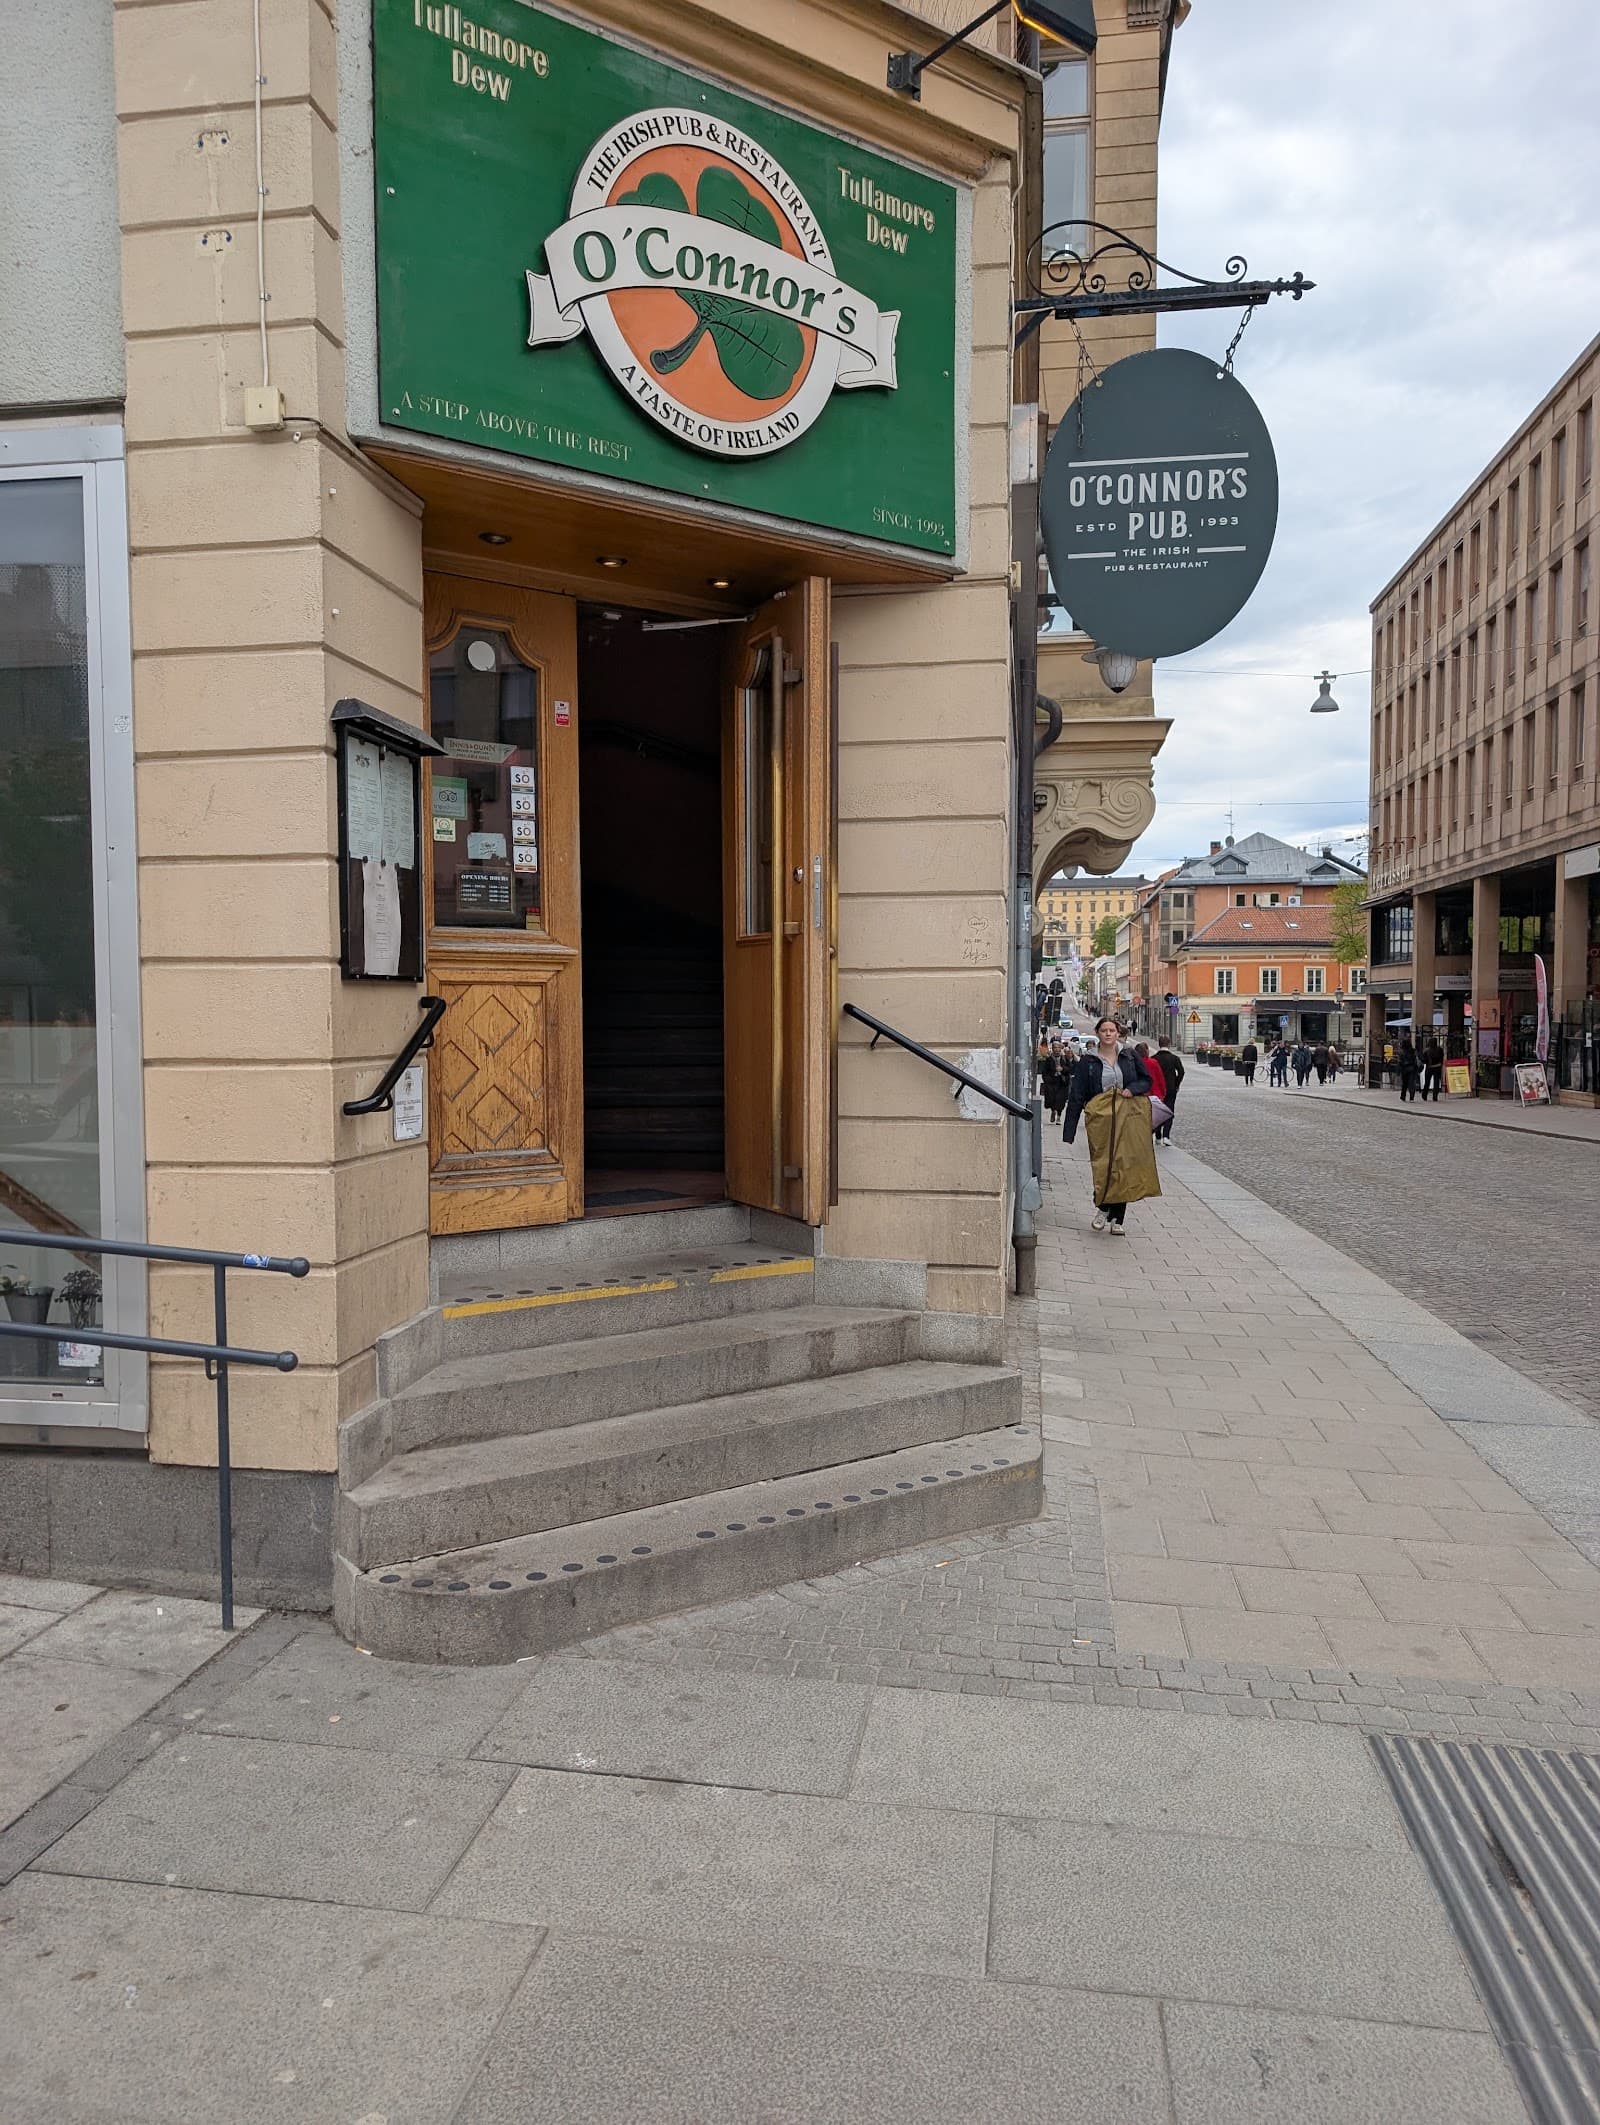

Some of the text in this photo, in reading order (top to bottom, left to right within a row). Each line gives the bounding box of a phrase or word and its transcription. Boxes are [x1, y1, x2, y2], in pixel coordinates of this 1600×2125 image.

[413, 0, 550, 79] Tullamore
[452, 48, 512, 103] Dew
[587, 115, 827, 260] THE IRISH PUB & RESTAURANT
[838, 166, 935, 233] Tullamore
[867, 213, 909, 254] Dew
[572, 227, 858, 335] O'Connor's
[400, 390, 632, 461] A STEP ABOVE THE REST
[620, 365, 800, 449] A TASTE OF IRELAND
[1069, 467, 1248, 507] O'CONNOR'S
[872, 506, 945, 537] SINCE 1993
[1075, 510, 1239, 541] ESTD PUB. 1993
[1104, 564, 1126, 572] PUB
[1137, 561, 1209, 571] RESTAURANT
[1122, 546, 1191, 557] THE IRISH
